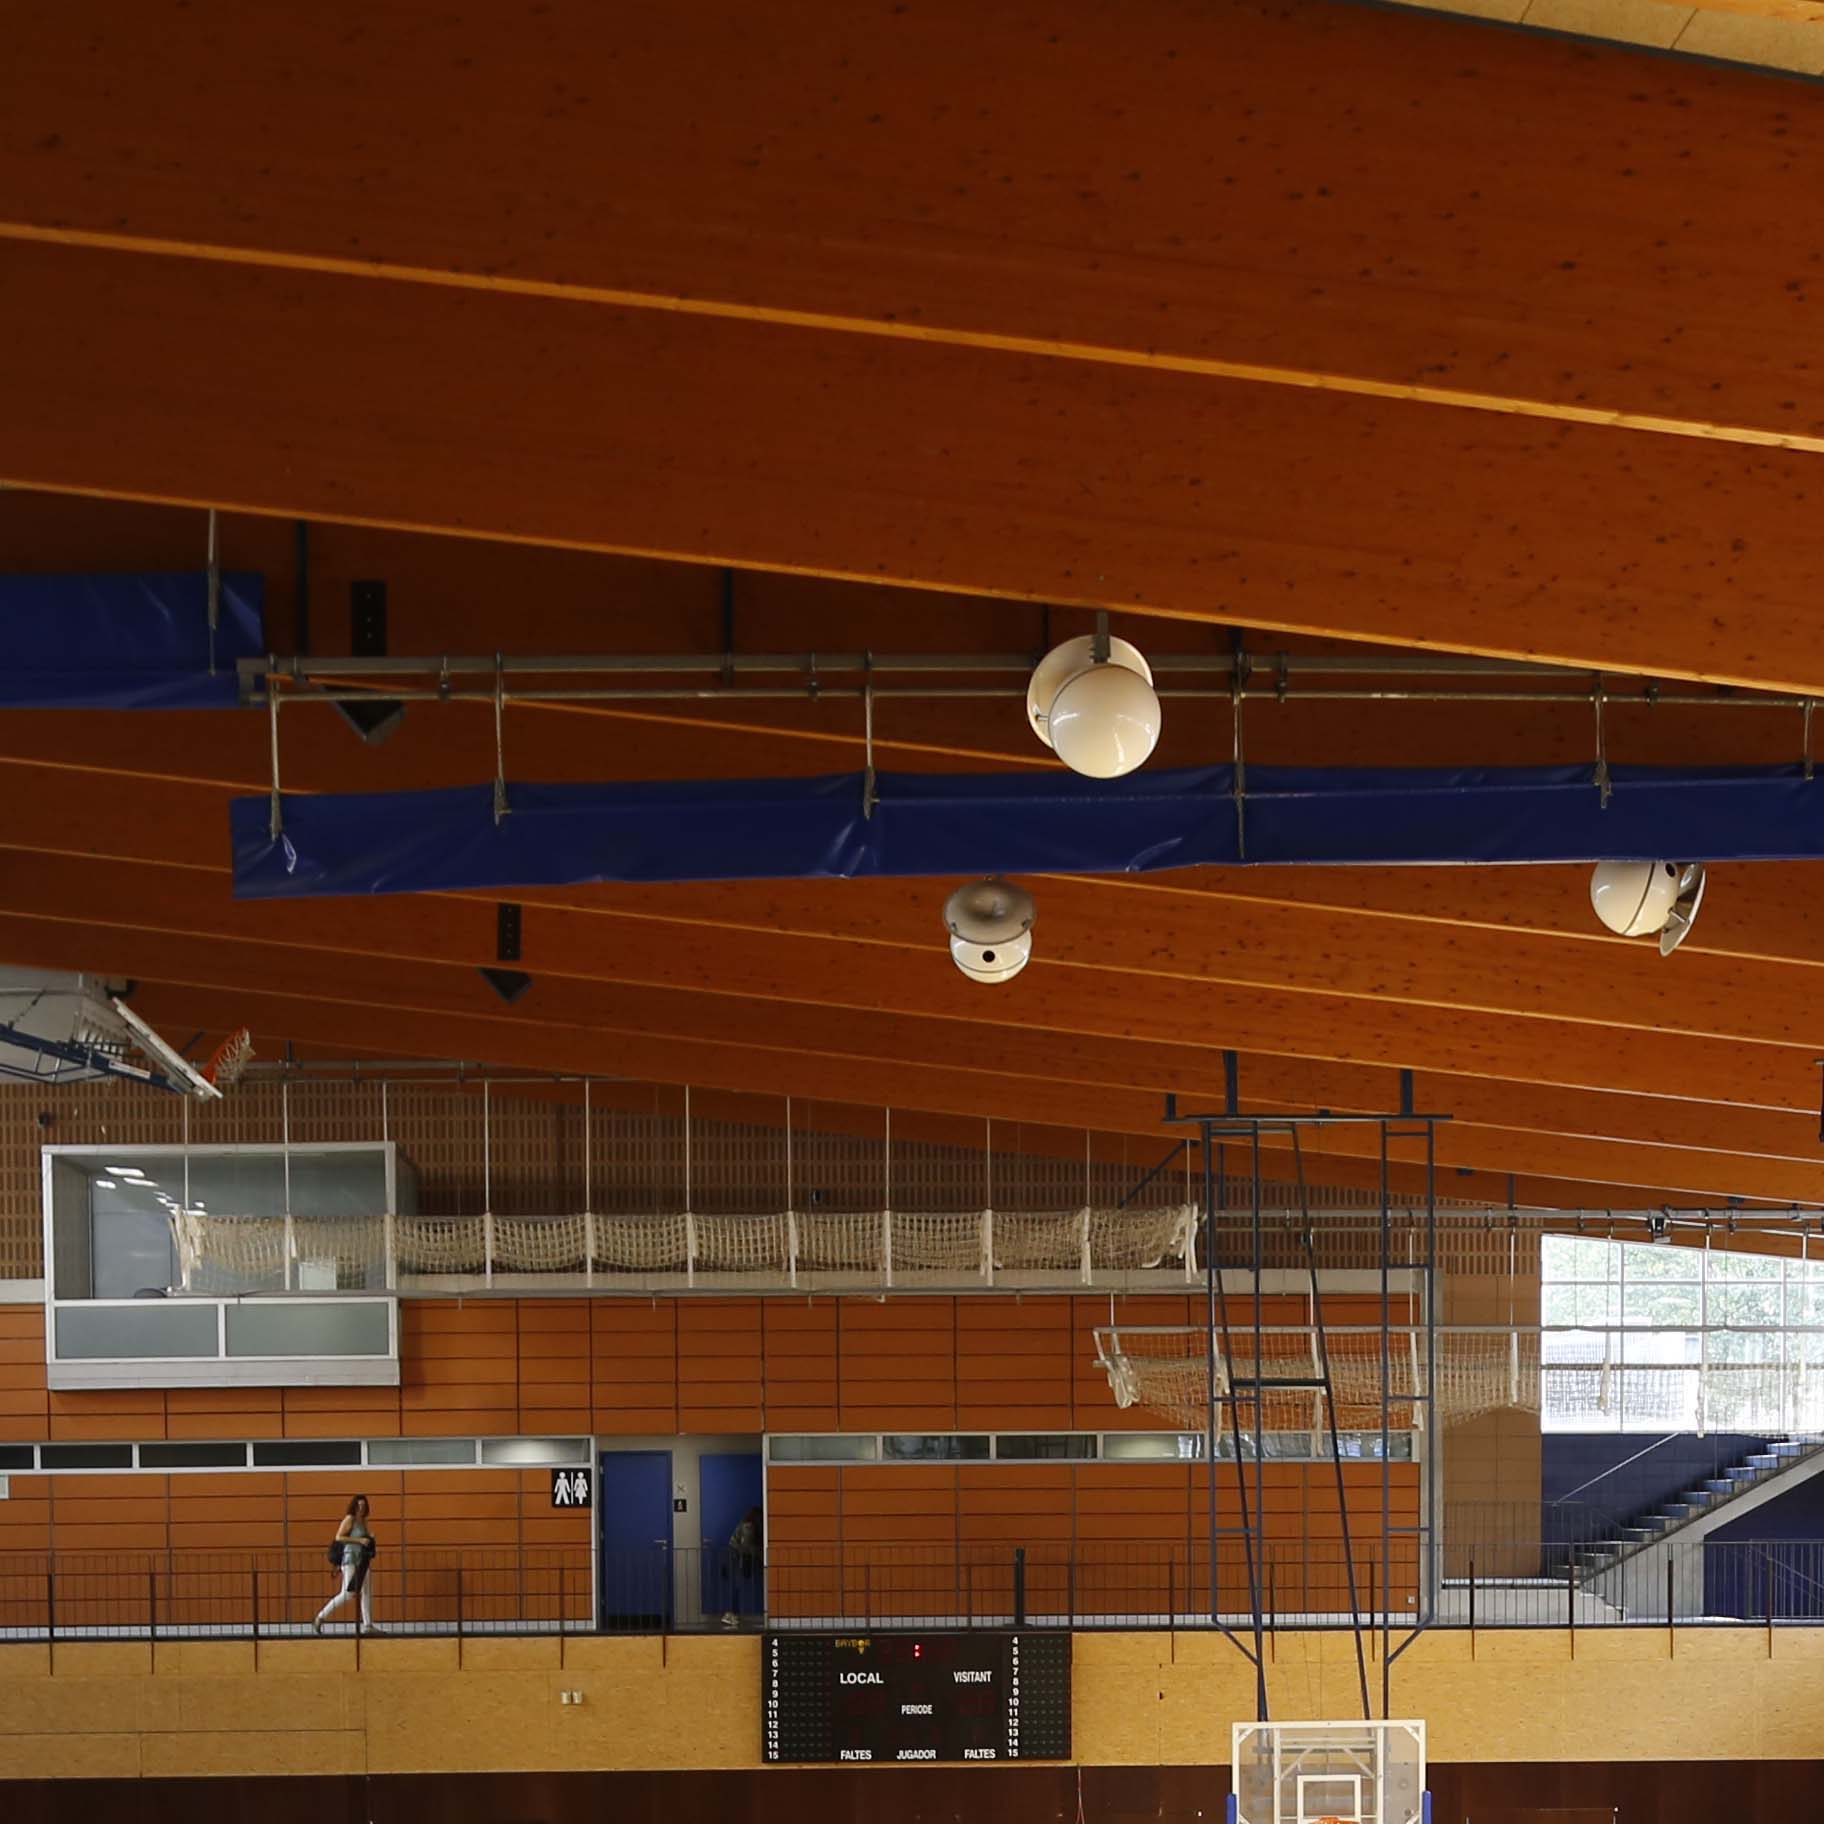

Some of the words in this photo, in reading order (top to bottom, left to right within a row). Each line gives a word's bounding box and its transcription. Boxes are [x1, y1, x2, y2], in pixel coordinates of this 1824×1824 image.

[772, 1649, 778, 1657] 5
[1012, 1647, 1019, 1655] 5
[1012, 1657, 1019, 1665] 6
[840, 1673, 884, 1684] LOCAL
[953, 1671, 992, 1683] VISITANT
[772, 1690, 778, 1698] 9
[768, 1700, 778, 1708] 10
[1008, 1698, 1019, 1706] 10
[901, 1704, 932, 1714] PERIODE
[1008, 1708, 1019, 1716] 11
[768, 1751, 778, 1759] 15
[841, 1750, 871, 1760] FALTES
[897, 1750, 936, 1760] JUGADOR
[964, 1749, 995, 1759] FALTES
